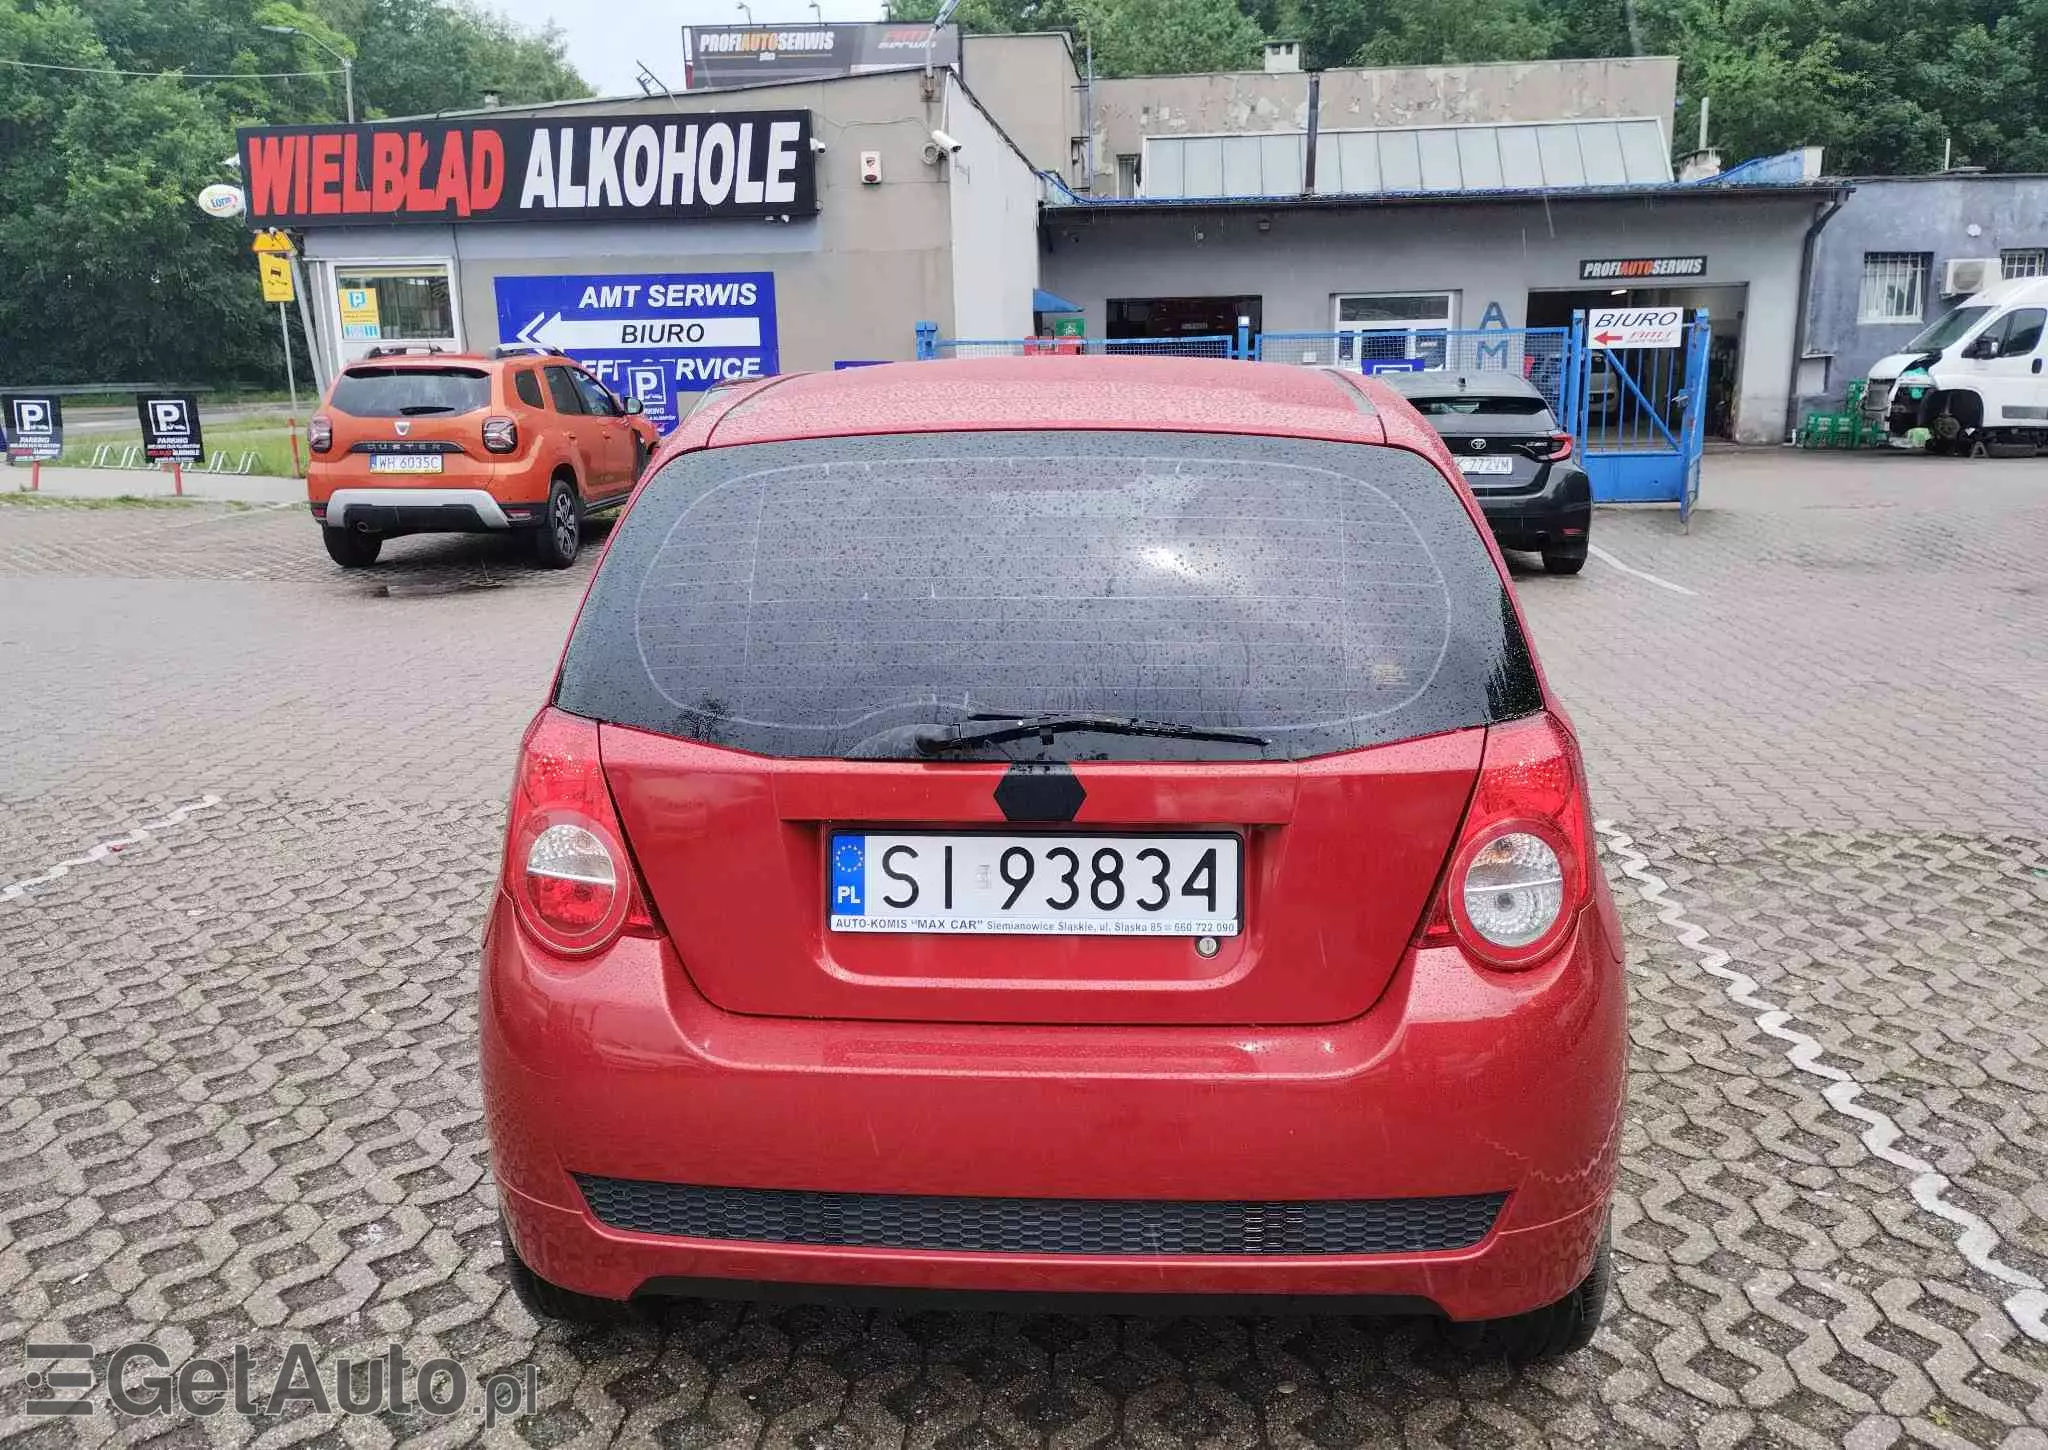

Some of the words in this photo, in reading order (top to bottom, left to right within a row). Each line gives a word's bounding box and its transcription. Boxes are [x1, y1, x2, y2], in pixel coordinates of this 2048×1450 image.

[700, 32, 835, 52] PROFIAUTOSERWIS
[248, 129, 505, 217] WIELBŁĄD
[519, 121, 801, 209] ALKOHOLE
[1584, 258, 1704, 279] PROFIAUTOSERWIS
[578, 286, 642, 309] AMT
[647, 283, 758, 308] SERWIS
[1594, 312, 1678, 328] BIURO
[621, 323, 705, 344] BIURO
[642, 357, 764, 382] RVICE
[21, 404, 43, 431] P
[156, 404, 180, 431] P
[882, 844, 953, 909] SI
[1000, 846, 1217, 912] 93834
[838, 886, 861, 904] PL
[836, 918, 907, 929] AUTO-KOMIS
[987, 920, 1055, 931] Siemianowice
